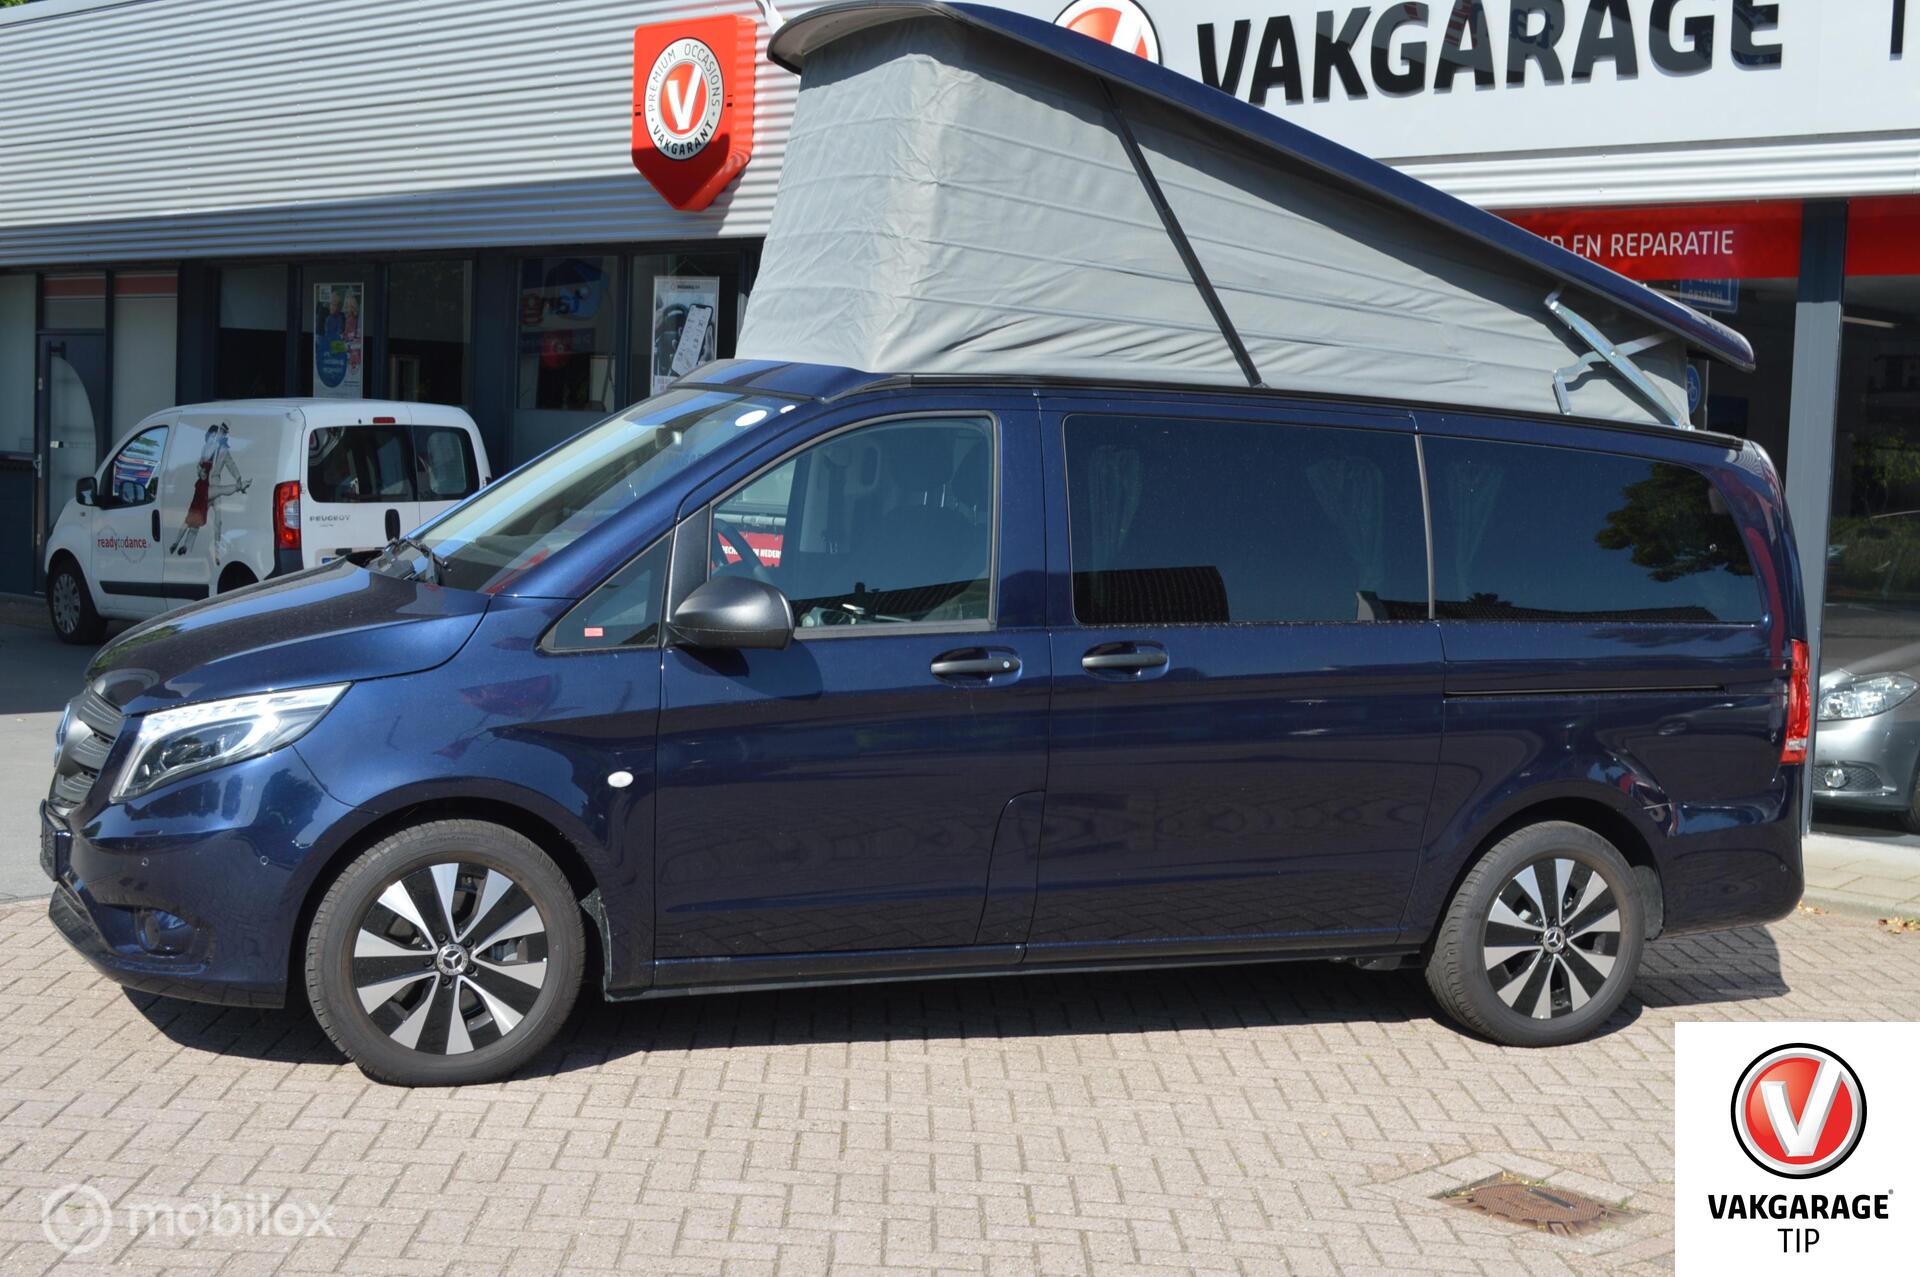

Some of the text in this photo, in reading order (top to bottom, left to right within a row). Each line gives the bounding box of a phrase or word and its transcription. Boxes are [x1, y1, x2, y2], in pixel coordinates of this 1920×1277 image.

[1197, 0, 1783, 106] VAKGARAGE
[648, 43, 721, 112] PREMIUM OCCASIONS
[653, 121, 714, 156] VAKGARANT
[1573, 234, 1602, 258] EN
[1610, 230, 1735, 258] REPARATIE
[309, 514, 351, 522] PEUGEOT
